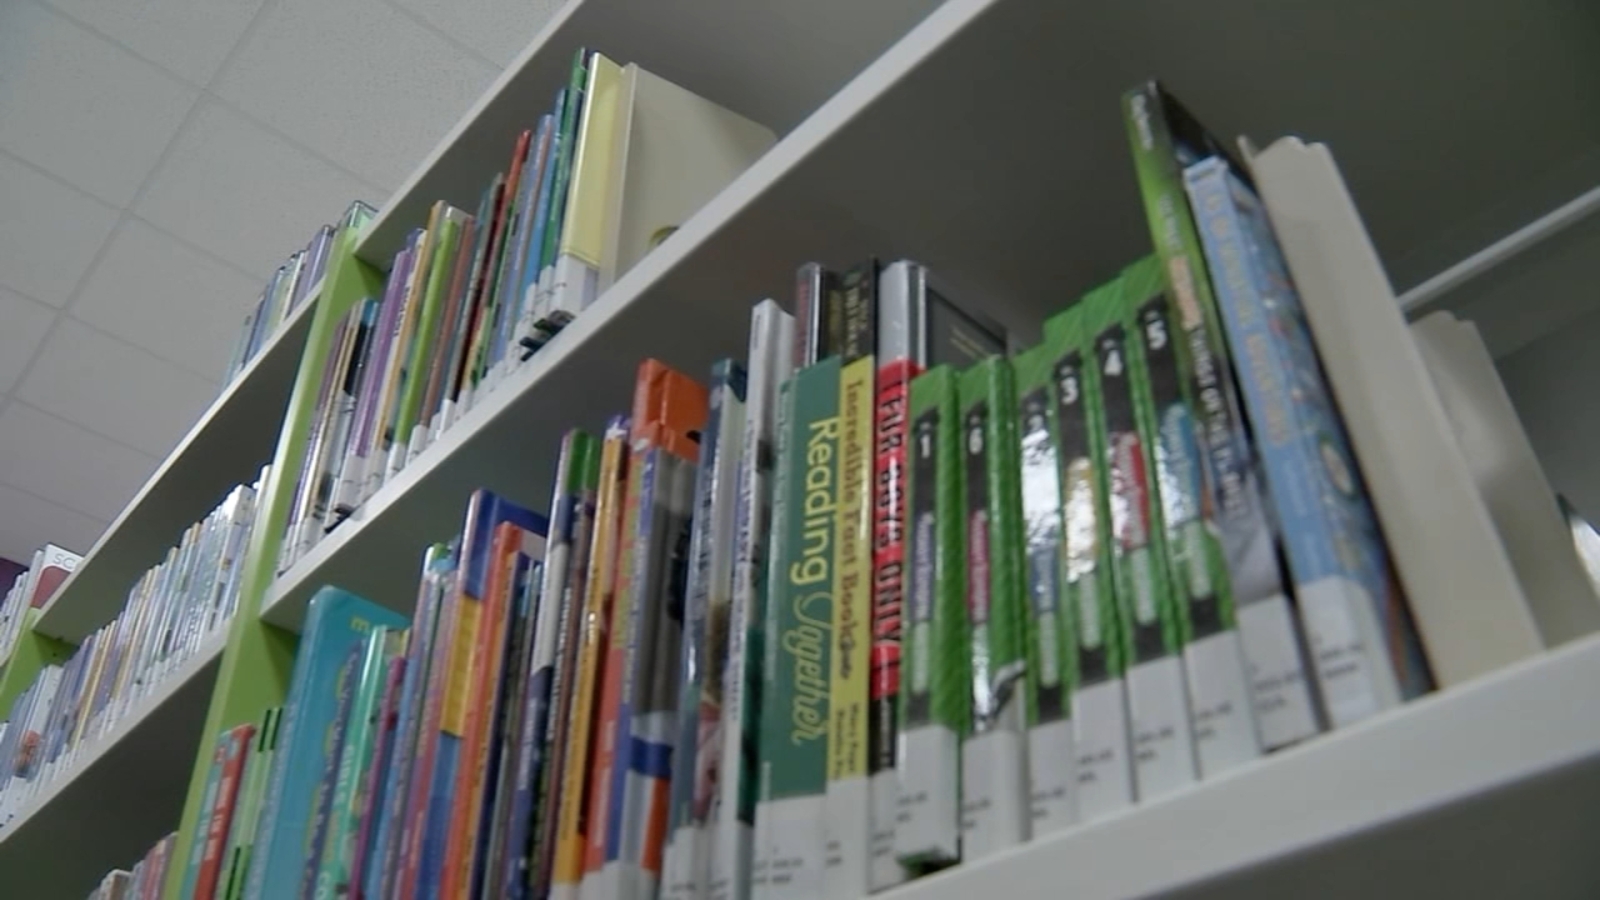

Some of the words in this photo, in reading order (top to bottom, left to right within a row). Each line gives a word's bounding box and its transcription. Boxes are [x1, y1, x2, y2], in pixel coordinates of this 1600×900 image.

[1104, 350, 1122, 375] 4
[1147, 320, 1167, 349] 5
[1060, 377, 1078, 405] 3
[844, 380, 863, 502] Incredible
[790, 416, 839, 585] Reading
[842, 508, 860, 566] Fact
[782, 590, 833, 745] Together
